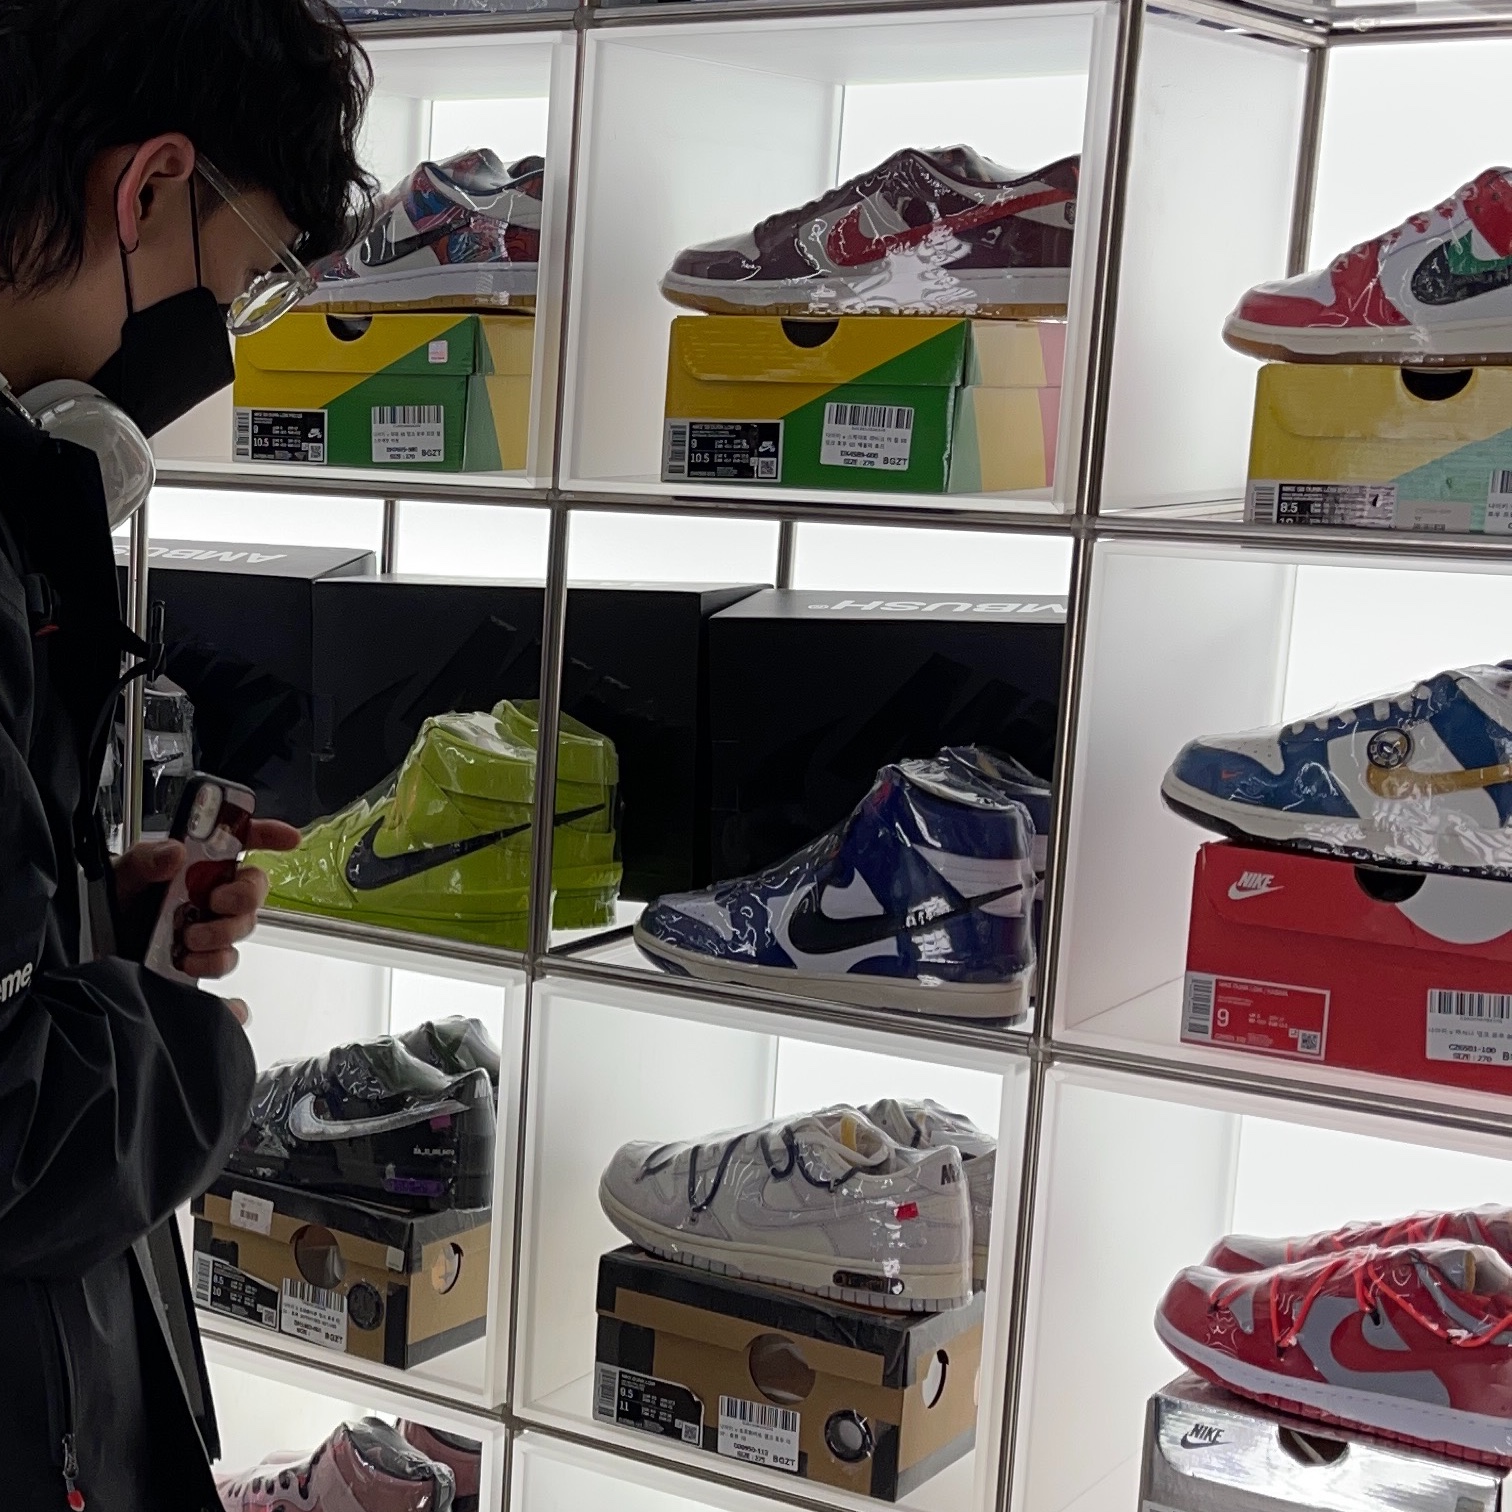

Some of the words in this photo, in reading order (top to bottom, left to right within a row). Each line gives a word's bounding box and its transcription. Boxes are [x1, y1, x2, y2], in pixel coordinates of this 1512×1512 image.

[882, 456, 908, 466] BGZT
[1280, 502, 1298, 513] 8.5
[830, 600, 1068, 614] MBUSH
[1216, 1008, 1229, 1028] 9
[619, 1400, 629, 1412] 11
[1187, 1423, 1226, 1443] NIKE
[772, 1454, 796, 1467] BGZT
